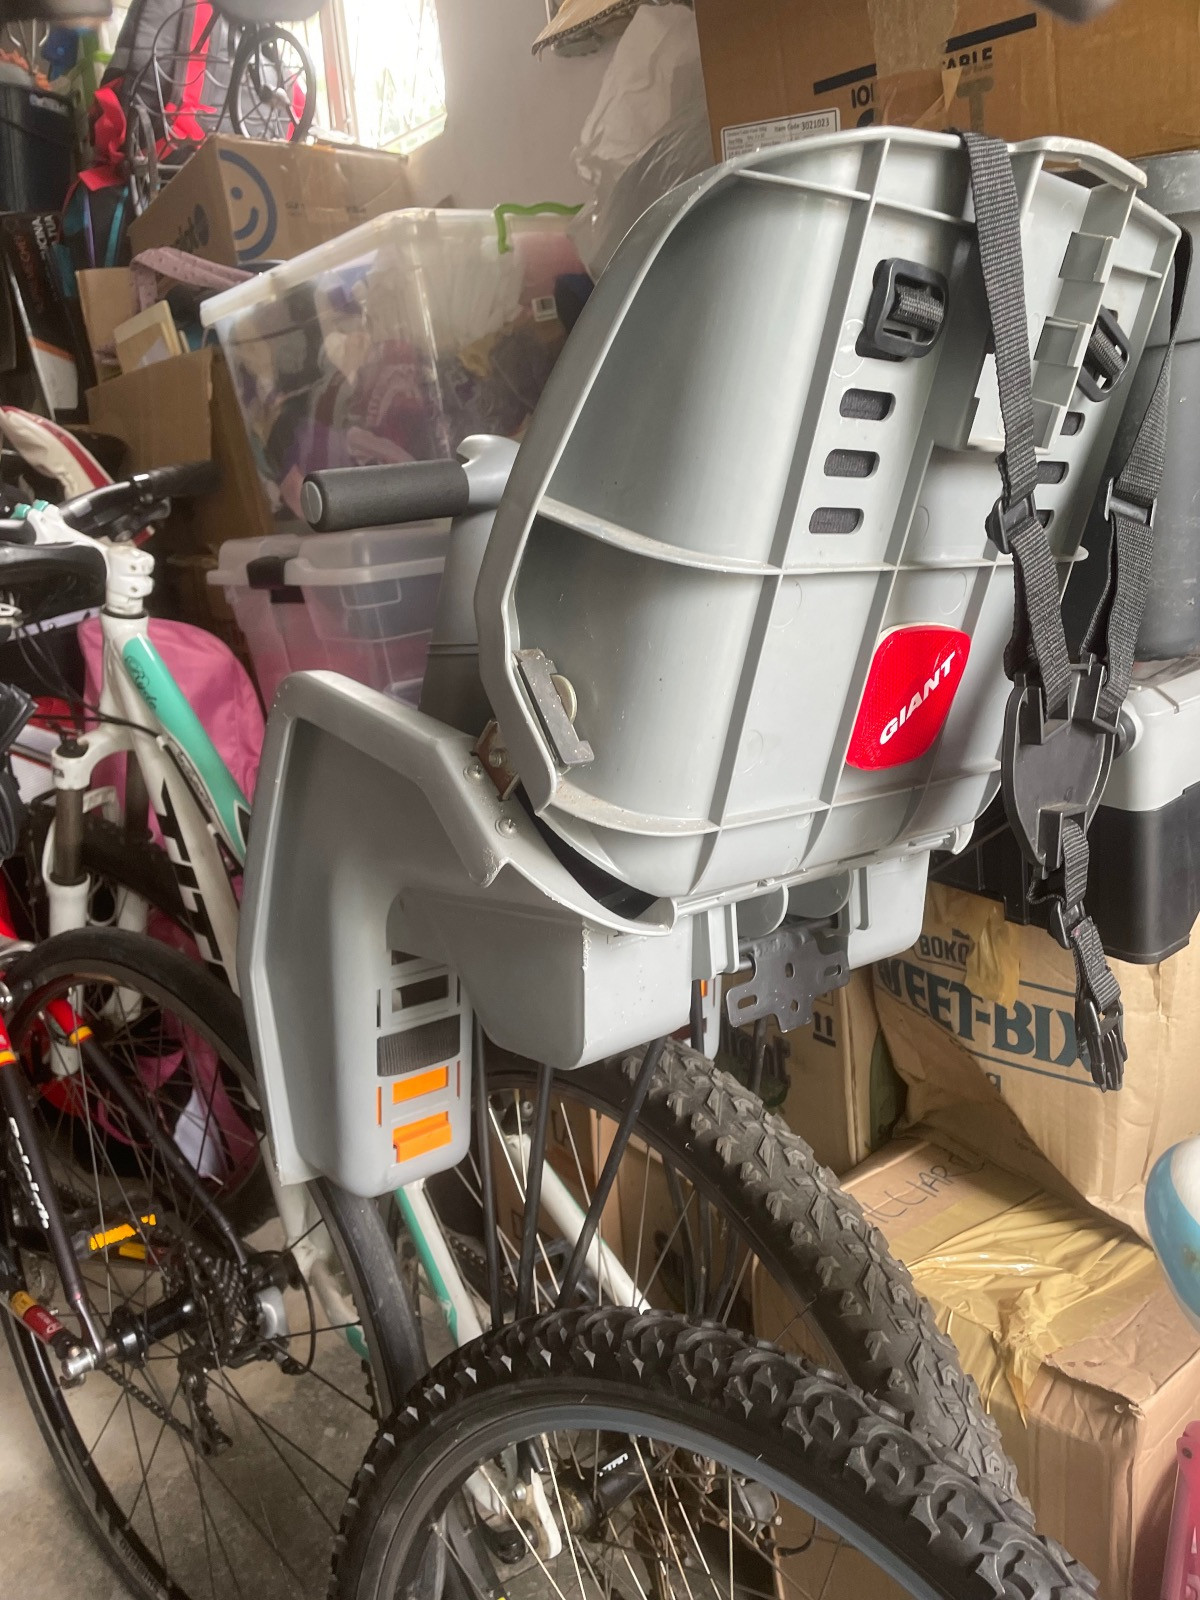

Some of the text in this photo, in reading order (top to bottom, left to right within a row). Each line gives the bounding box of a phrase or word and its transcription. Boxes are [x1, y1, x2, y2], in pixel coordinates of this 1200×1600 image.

[786, 122, 800, 131] Code
[801, 118, 830, 131] 3021023
[879, 651, 956, 745] GIANT
